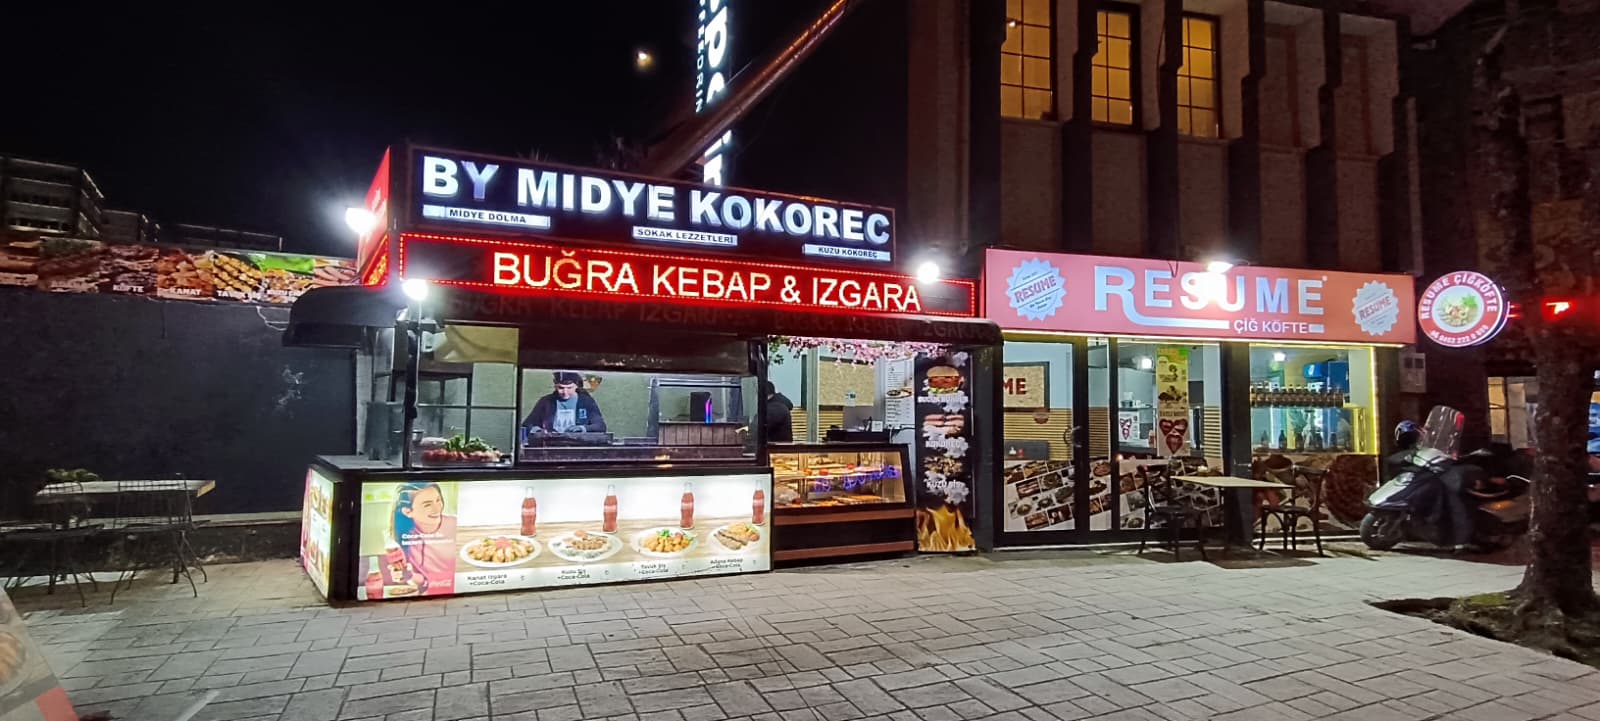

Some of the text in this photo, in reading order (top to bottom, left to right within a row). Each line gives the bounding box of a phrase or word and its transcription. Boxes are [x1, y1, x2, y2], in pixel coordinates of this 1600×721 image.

[423, 155, 890, 244] BY MIDYE KOKOREC
[449, 208, 527, 224] MIDYE DOLMA
[637, 228, 673, 239] SOKAK
[818, 246, 840, 255] KUZU
[493, 250, 921, 312] BUĞRA KEBAP & IZGARA
[1014, 275, 1057, 303] RESUME
[1094, 265, 1325, 329] RESUME
[1359, 296, 1392, 320] RESUME
[1421, 277, 1450, 319] RESUME
[1233, 317, 1308, 335] ÇİĞ KÖFTE
